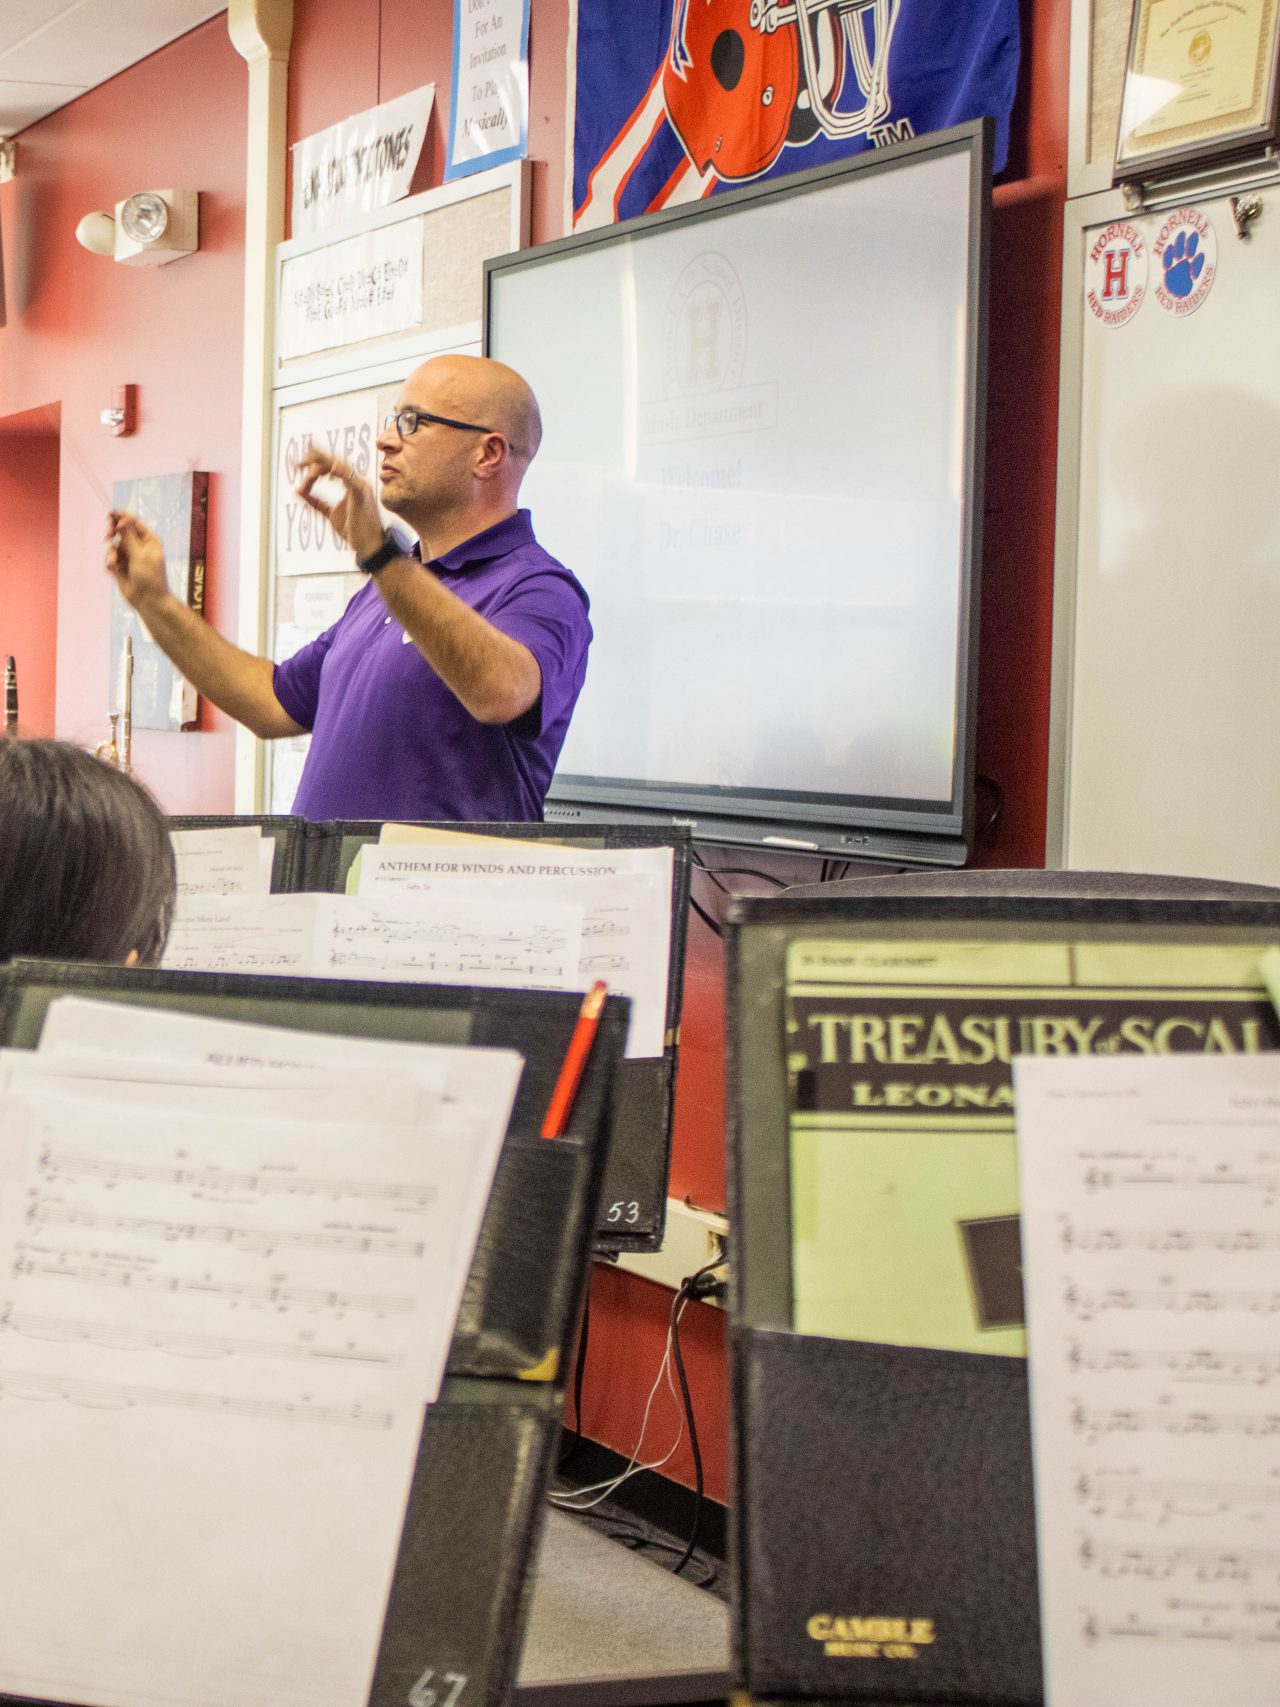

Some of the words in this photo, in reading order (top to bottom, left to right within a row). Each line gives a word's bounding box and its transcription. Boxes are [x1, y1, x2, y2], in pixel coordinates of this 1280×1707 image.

[491, 15, 502, 32] An
[472, 85, 483, 102] To
[866, 117, 915, 149] TM
[1090, 224, 1143, 264] HORNELL
[1154, 207, 1209, 255] HORNELL
[1102, 249, 1130, 300] H
[1155, 284, 1174, 310] RED
[1176, 265, 1214, 314] RAIDERS
[1087, 288, 1104, 318] RED
[1104, 285, 1144, 325] RAIDERS
[687, 298, 723, 386] H
[685, 401, 764, 432] Department
[327, 422, 372, 480] YES
[660, 457, 743, 489] Welcome!
[378, 861, 432, 873] ANTHEM
[435, 862, 458, 873] FOR
[462, 863, 504, 874] WINDS
[507, 865, 536, 875] AND
[539, 865, 617, 877] PERCUSSION
[808, 1014, 1104, 1065] TREASURY
[607, 1201, 639, 1224] 53
[408, 1666, 466, 1707] 67
